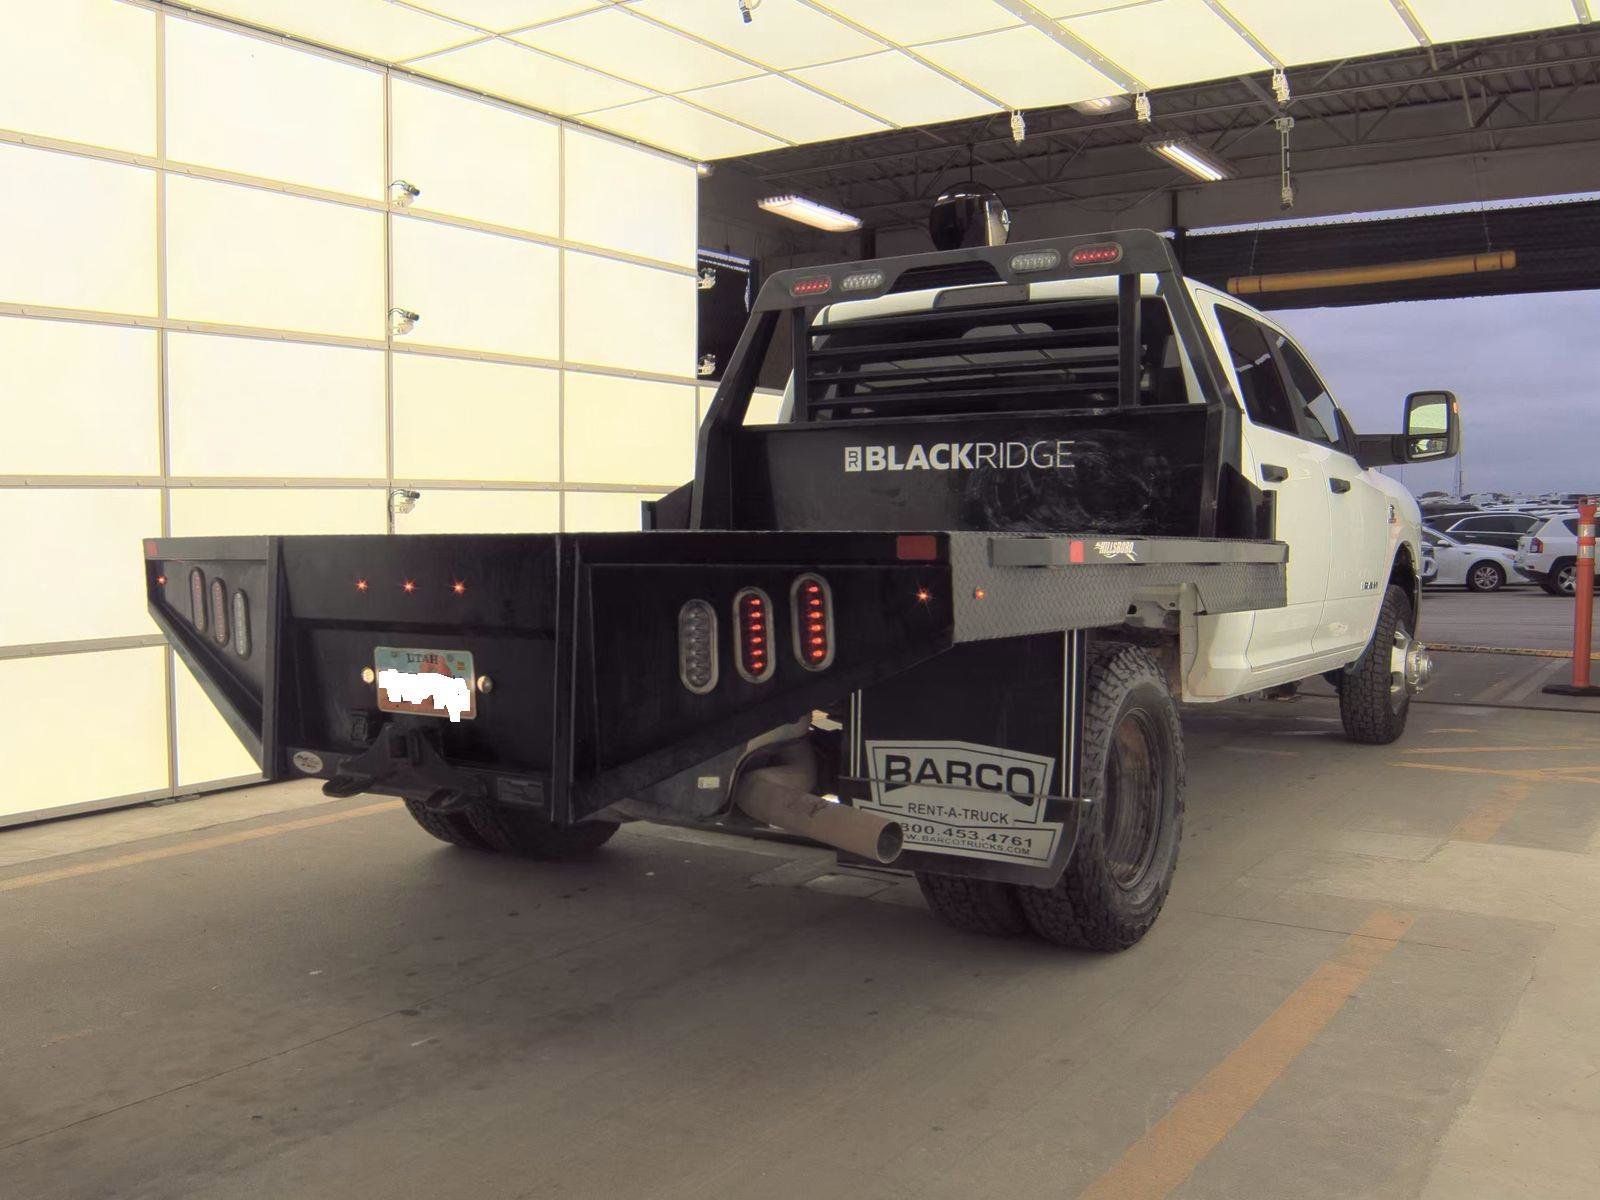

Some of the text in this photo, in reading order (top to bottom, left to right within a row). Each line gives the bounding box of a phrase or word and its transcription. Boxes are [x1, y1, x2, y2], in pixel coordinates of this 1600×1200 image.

[866, 440, 1075, 471] BLACKRIDGE
[407, 653, 439, 664] UTAH
[885, 754, 1035, 806] BARCO
[908, 803, 1009, 824] RENT-A-TRUCK
